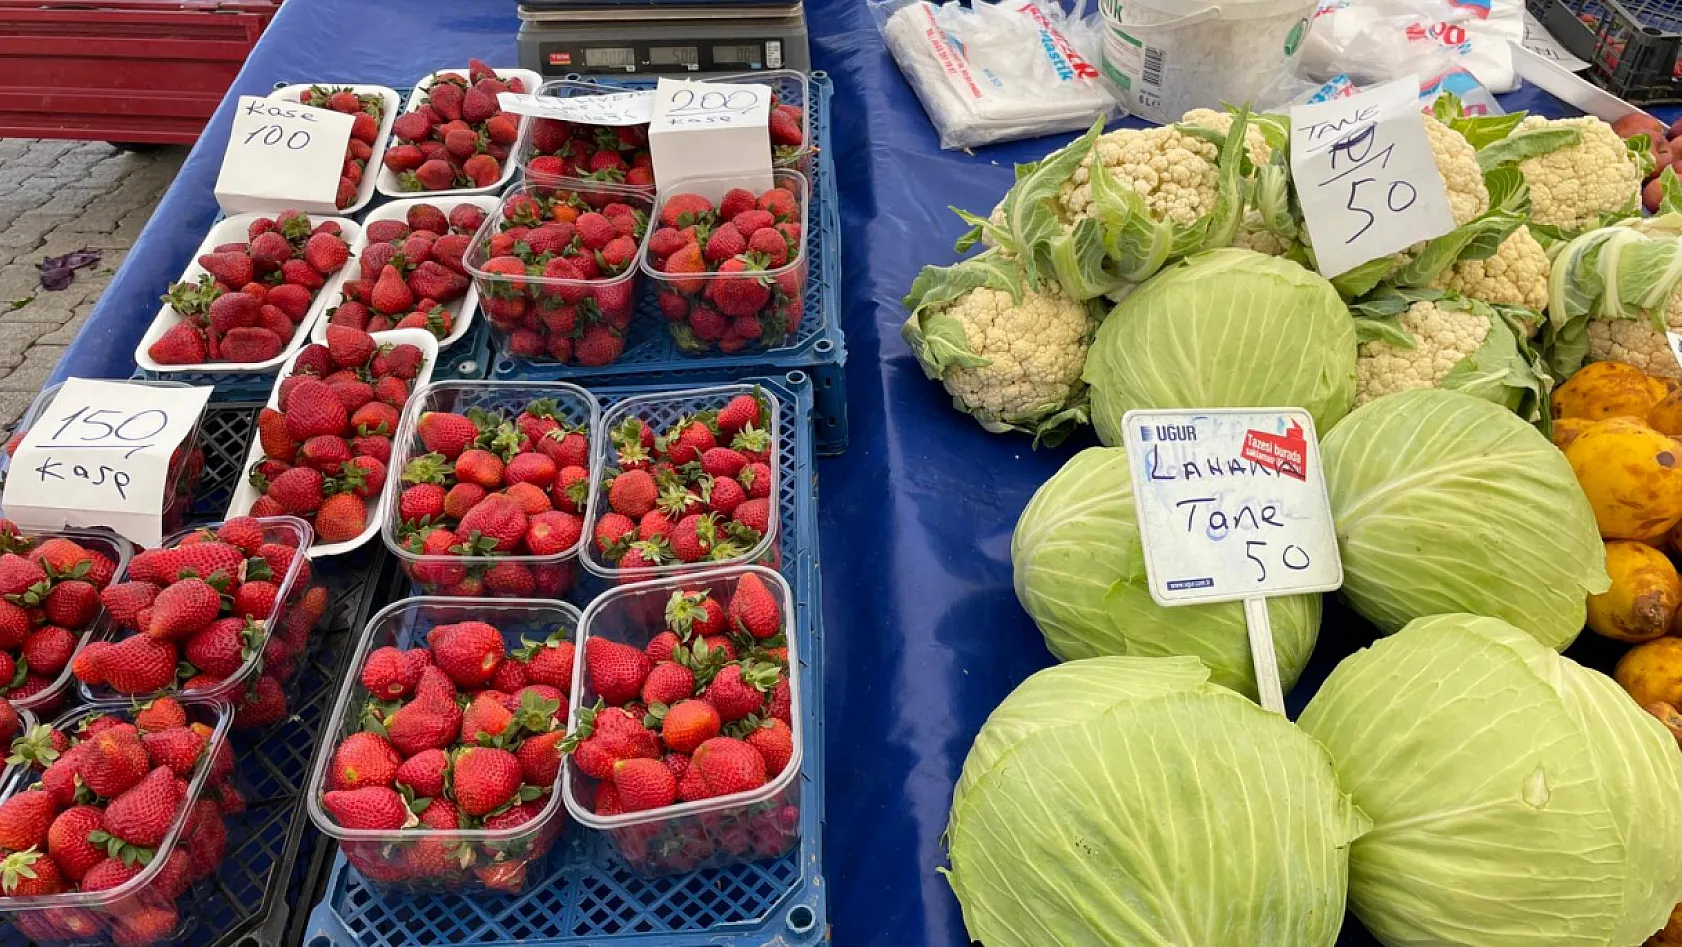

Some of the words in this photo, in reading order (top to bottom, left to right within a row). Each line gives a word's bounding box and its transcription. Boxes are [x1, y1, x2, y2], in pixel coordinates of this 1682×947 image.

[670, 89, 758, 113] 200
[244, 125, 311, 150] 100
[1345, 177, 1418, 244] 50
[52, 405, 168, 441] 150
[1176, 498, 1285, 532] Tane
[1246, 540, 1310, 582] 50
